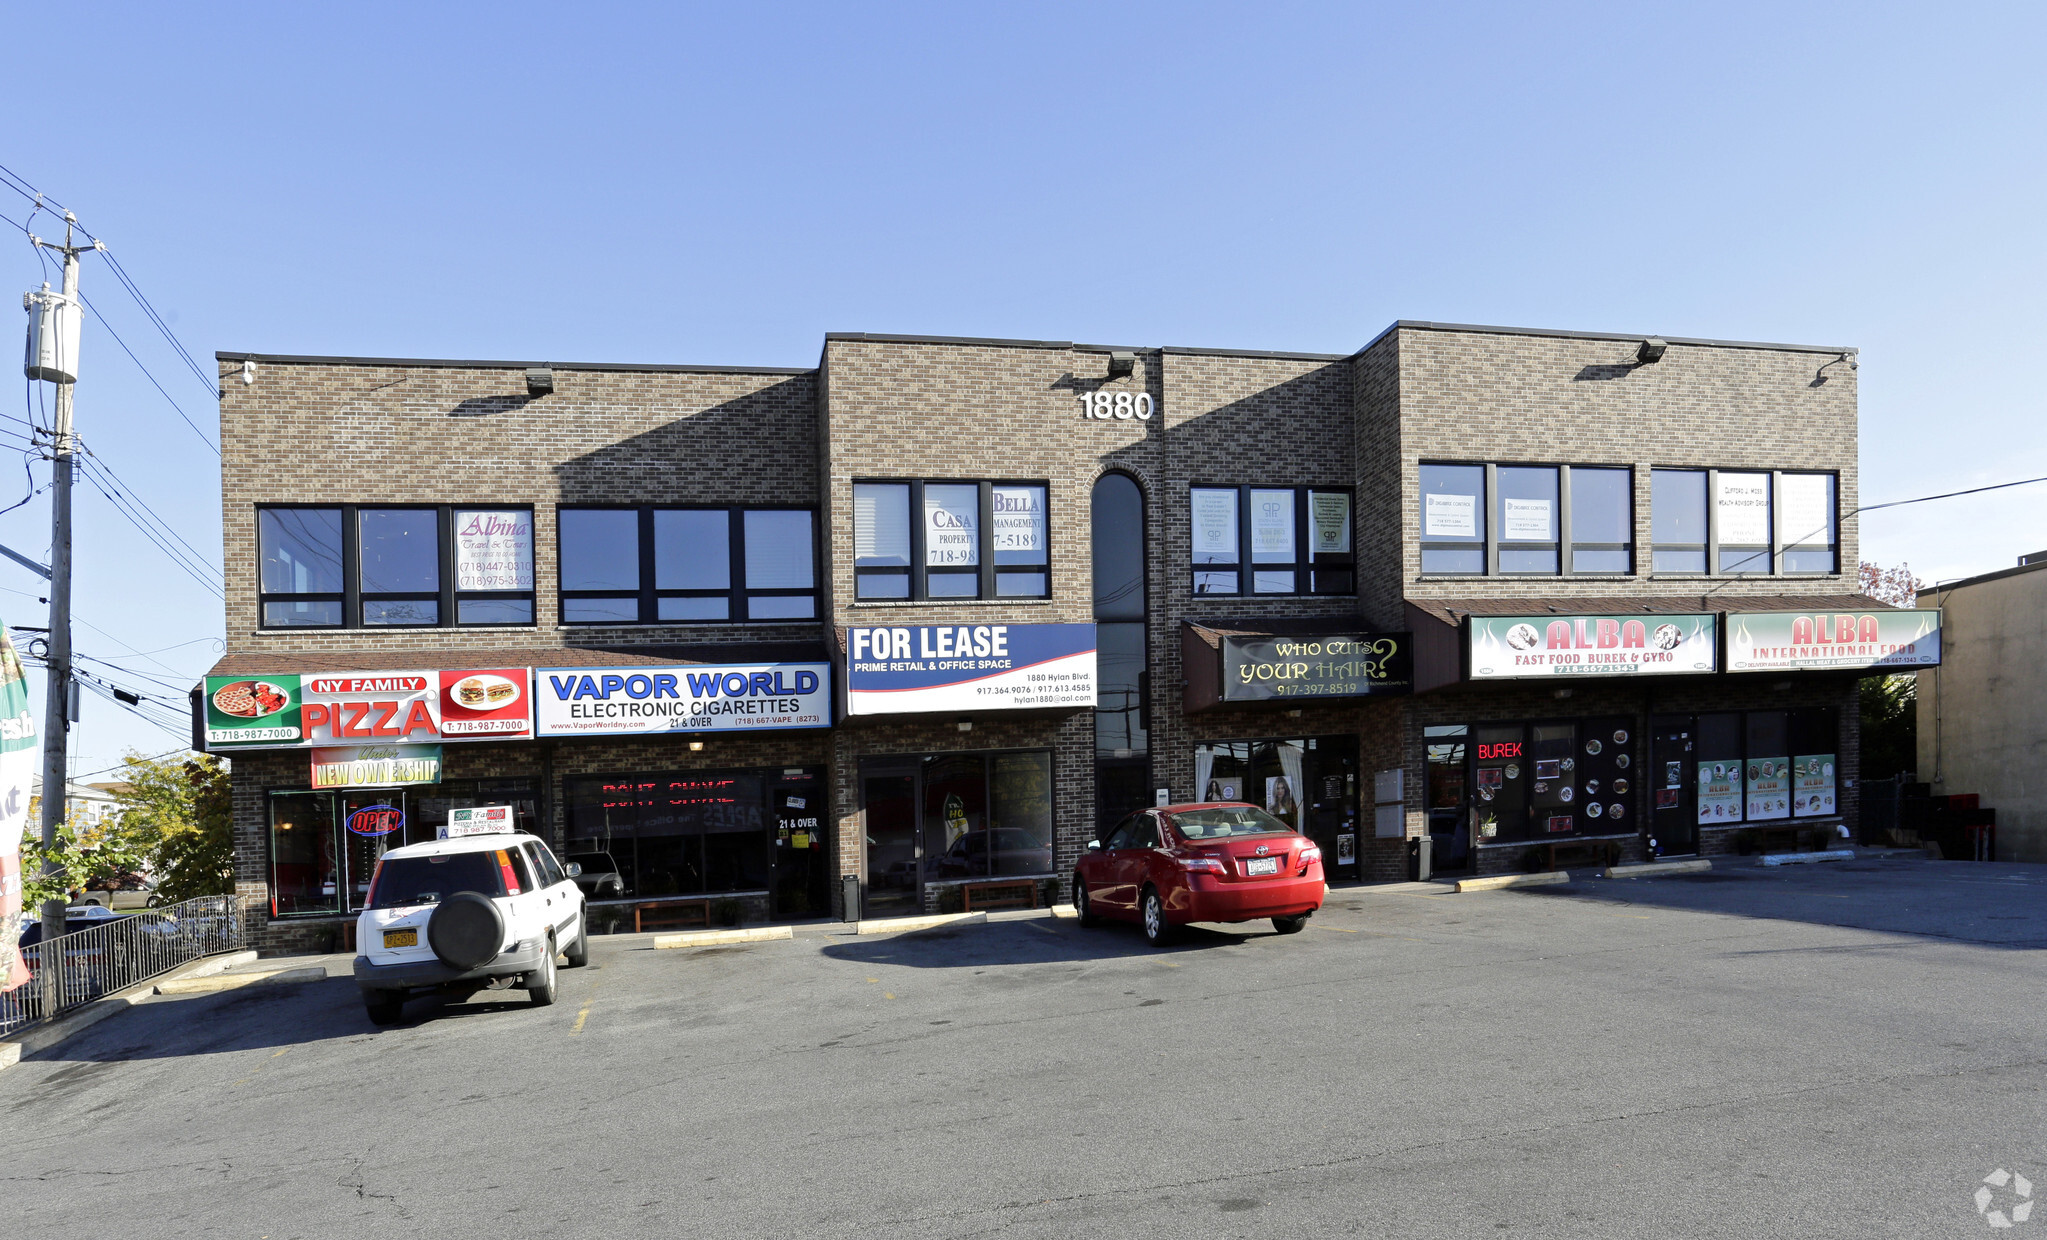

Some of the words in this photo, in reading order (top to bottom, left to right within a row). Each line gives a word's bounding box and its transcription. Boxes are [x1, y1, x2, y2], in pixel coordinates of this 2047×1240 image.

[1080, 392, 1154, 420] 1880
[460, 514, 529, 536] Albina
[994, 519, 1040, 528] MANAGEMENT
[461, 540, 489, 548] Travel
[939, 534, 975, 544] PROPERTY
[995, 534, 1037, 546] 7-5189
[460, 562, 531, 572] (718)447-0310
[1546, 619, 1646, 650] ALBA
[1792, 614, 1879, 645] ALBA
[853, 628, 912, 660] FOR
[921, 626, 1008, 659] LEASE
[1276, 642, 1321, 657] WHO
[1326, 641, 1373, 655] CUTS
[1753, 645, 1875, 659] INTERNATIONAL
[1881, 644, 1915, 655] FOOD
[854, 661, 887, 672] PRIME
[890, 661, 926, 672] RETAIL
[928, 661, 935, 671] &
[939, 660, 976, 670] OFFICE
[978, 659, 1012, 670] SPACE
[1515, 654, 1545, 666] FAST
[1549, 654, 1580, 665] FOOD
[1588, 653, 1626, 664] BUREK
[1630, 653, 1639, 663] &
[1643, 652, 1674, 663] GYRO
[1027, 674, 1046, 682] 1880
[1048, 673, 1070, 682] Hylan
[1240, 662, 1310, 683] YOUR
[318, 680, 343, 692] NY
[351, 677, 419, 692] FAMILY
[549, 673, 680, 700] VAPOR
[687, 671, 819, 698] WORLD
[977, 686, 1031, 695] 917.364.9076
[1038, 684, 1091, 693] 917.613.4585
[1278, 682, 1357, 696] 917-397-8519
[571, 702, 685, 718] ELECTRONIC
[691, 699, 800, 715] CIGARETTES
[301, 700, 438, 739] PIZZA
[457, 720, 523, 731] 718-987-7000
[550, 721, 645, 729] www.VaporWorldny.com
[670, 718, 680, 728] 21
[682, 718, 688, 727] &
[690, 717, 712, 728] OVER
[735, 716, 754, 725] (718)
[756, 715, 792, 724] 667-VAPE
[796, 714, 820, 724] (8273)
[221, 728, 292, 740] 718-987-7000
[358, 746, 400, 759] Under
[1478, 742, 1522, 759] BUREK
[316, 763, 348, 786] NEW
[352, 760, 439, 784] OWNERSHIP
[474, 809, 504, 819] Family
[353, 811, 400, 832] OPEN
[779, 819, 788, 829] 21
[790, 818, 796, 828] &
[797, 817, 818, 828] OVER
[439, 829, 448, 839] A
